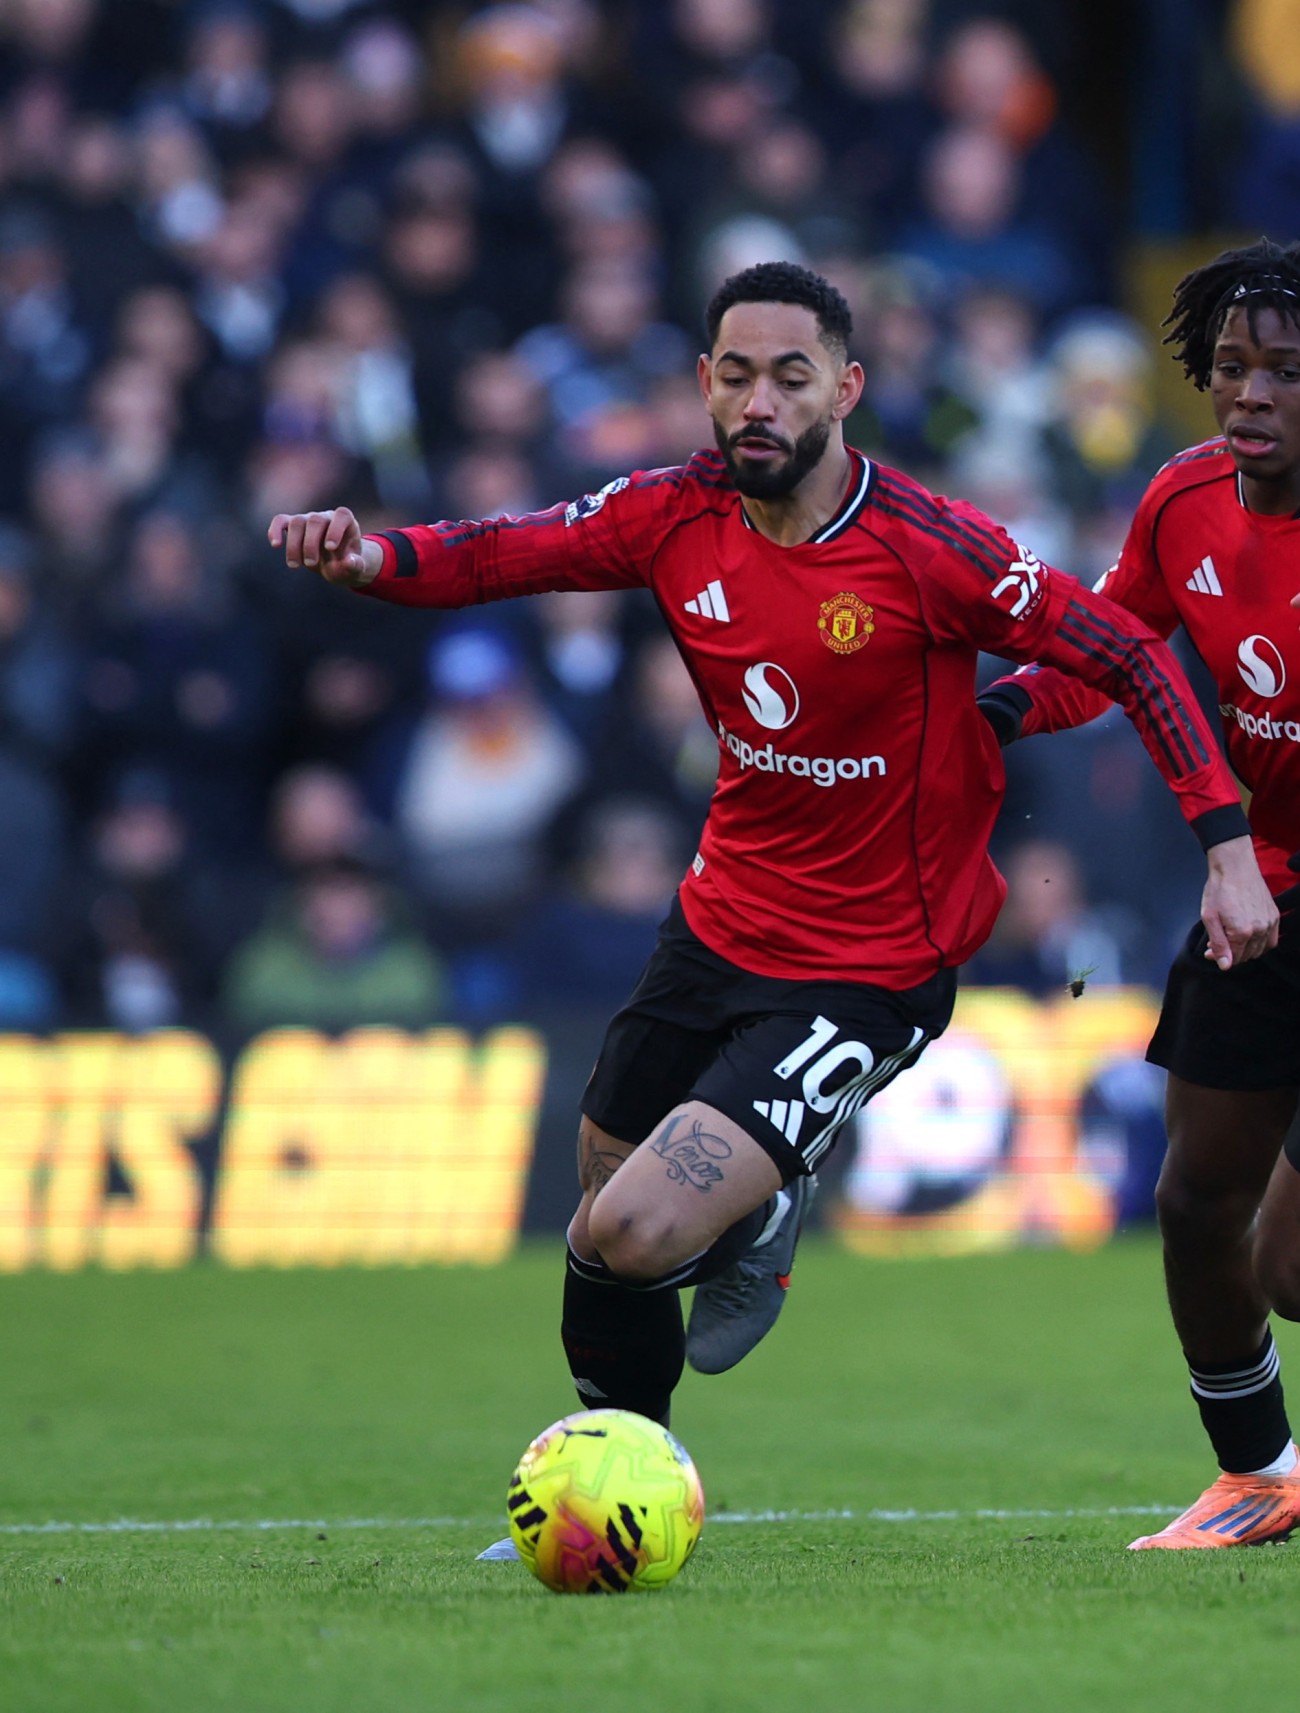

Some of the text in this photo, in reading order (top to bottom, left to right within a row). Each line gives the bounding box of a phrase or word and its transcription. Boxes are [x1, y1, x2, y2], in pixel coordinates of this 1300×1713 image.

[827, 638, 861, 650] UNITED
[718, 719, 886, 787] napdragon
[774, 1015, 874, 1114] 10
